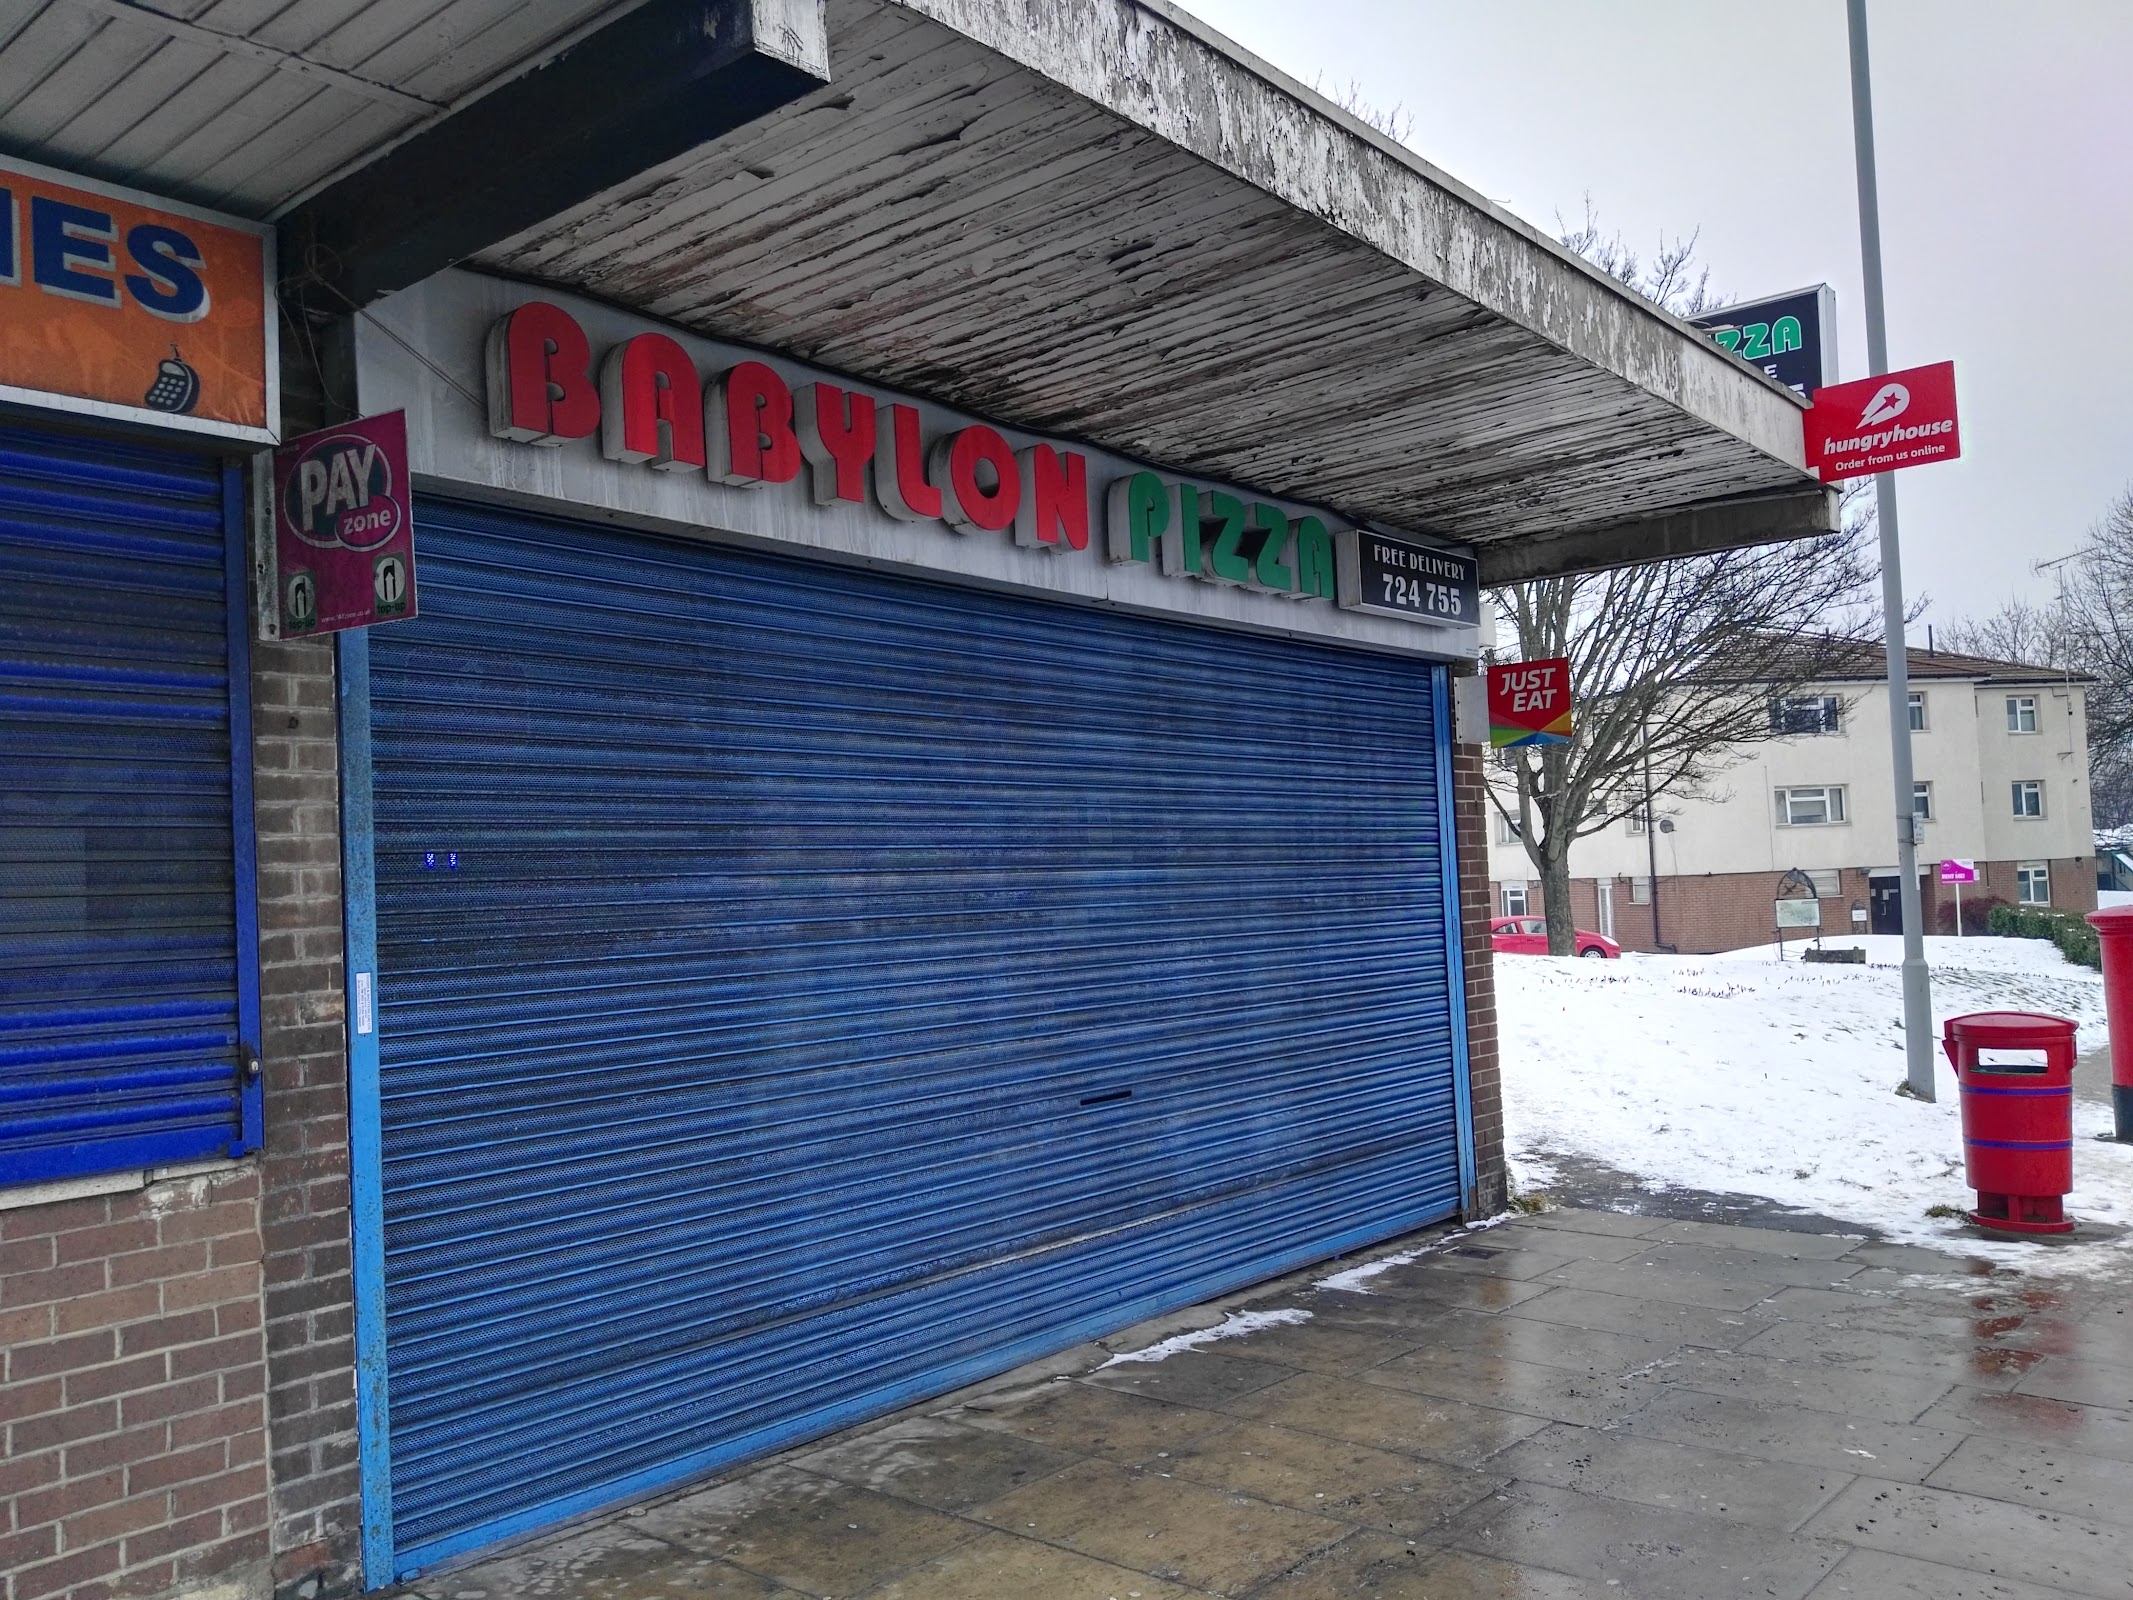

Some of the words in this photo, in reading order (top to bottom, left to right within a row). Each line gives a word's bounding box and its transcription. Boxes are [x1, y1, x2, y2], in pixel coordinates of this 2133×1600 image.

[1707, 316, 1802, 360] ZZA
[508, 301, 1088, 552] BABYLON
[1824, 420, 1953, 456] hungryhouse
[1835, 460, 1865, 471] Order
[1868, 455, 1893, 466] from
[1896, 451, 1908, 460] us
[1911, 445, 1945, 458] online
[301, 444, 376, 531] PAY
[343, 509, 391, 535] zone
[1126, 471, 1335, 600] PIZZA
[1374, 544, 1406, 568] FREE
[1409, 553, 1466, 581] DELIVERY
[376, 602, 406, 614] top-up
[1383, 573, 1420, 608] 724
[1426, 582, 1462, 615] 755
[1500, 667, 1556, 696] JUST
[1513, 689, 1557, 712] EAT
